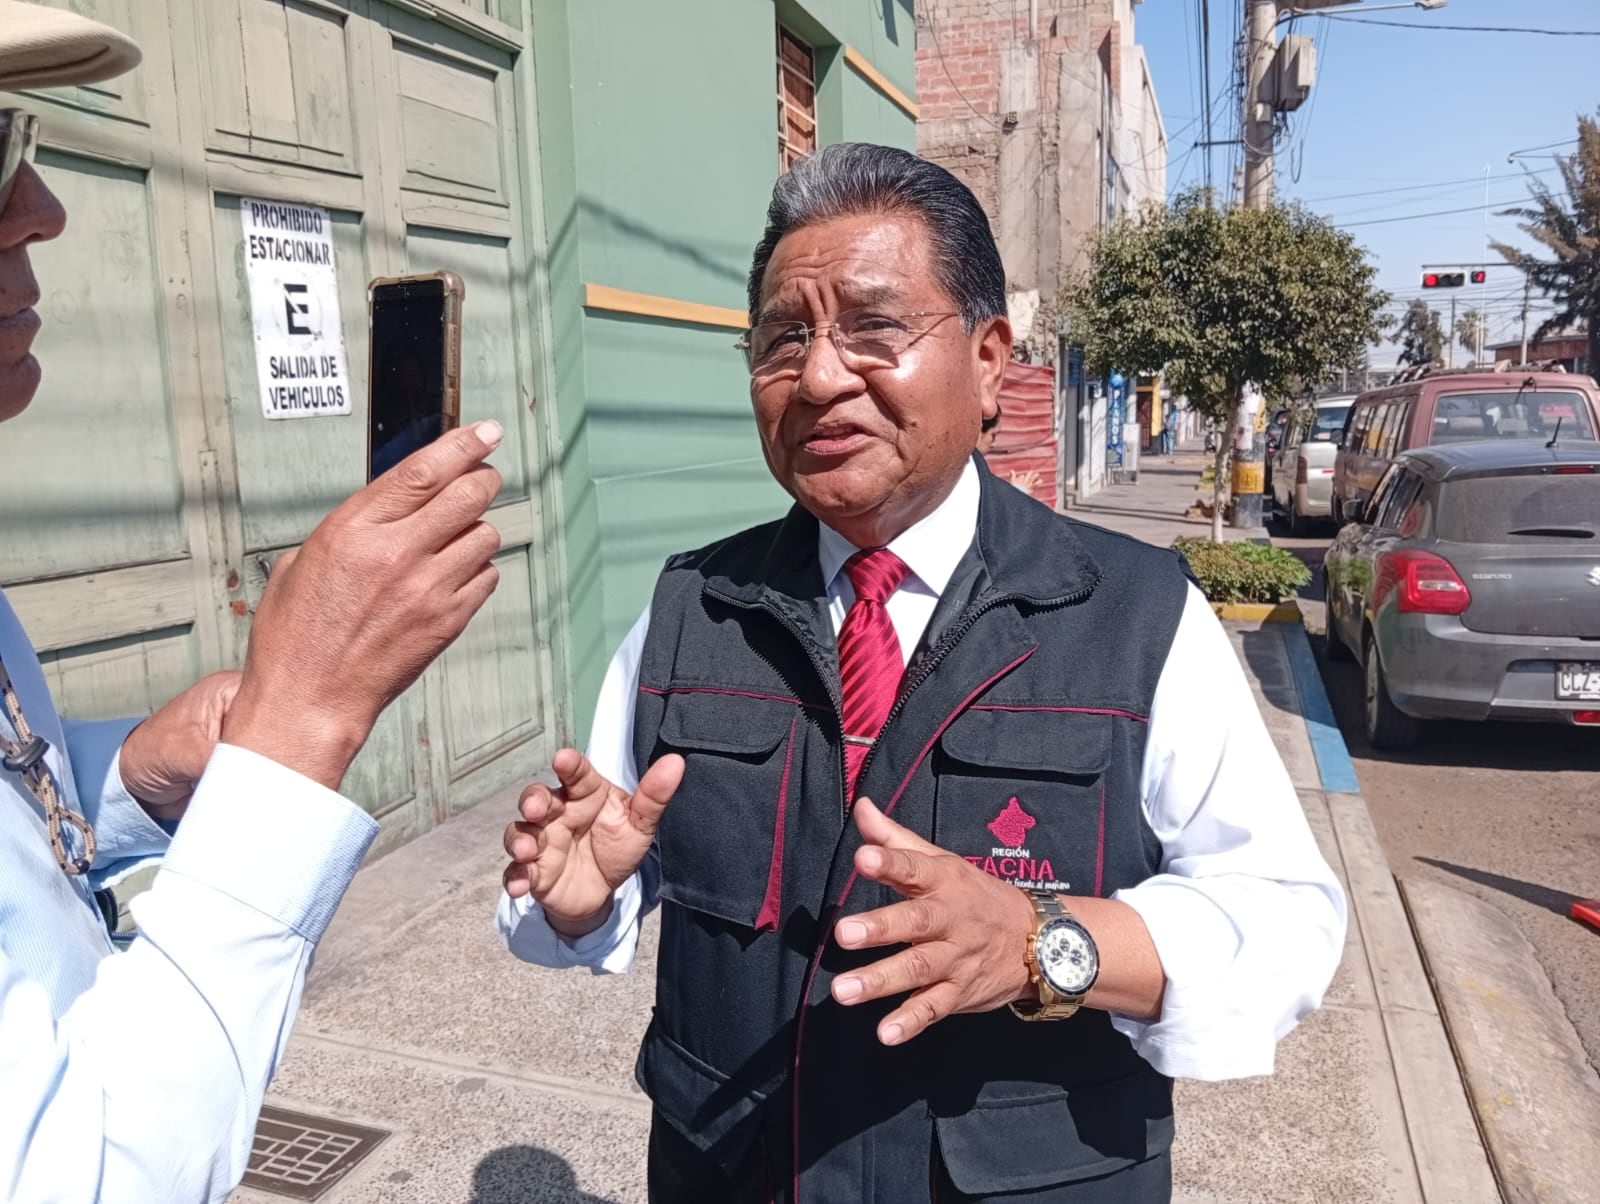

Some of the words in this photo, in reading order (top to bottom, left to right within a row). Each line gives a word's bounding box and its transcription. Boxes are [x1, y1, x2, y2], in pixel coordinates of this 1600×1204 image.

[251, 201, 323, 234] PROHIBIDO
[250, 235, 331, 265] ESTACIONAR
[283, 283, 313, 335] E
[270, 356, 318, 379] SALIDA
[321, 356, 338, 378] DE
[269, 385, 345, 411] VEHICULOS
[1561, 671, 1600, 691] CLZ-
[992, 847, 1030, 858] REGIÓN
